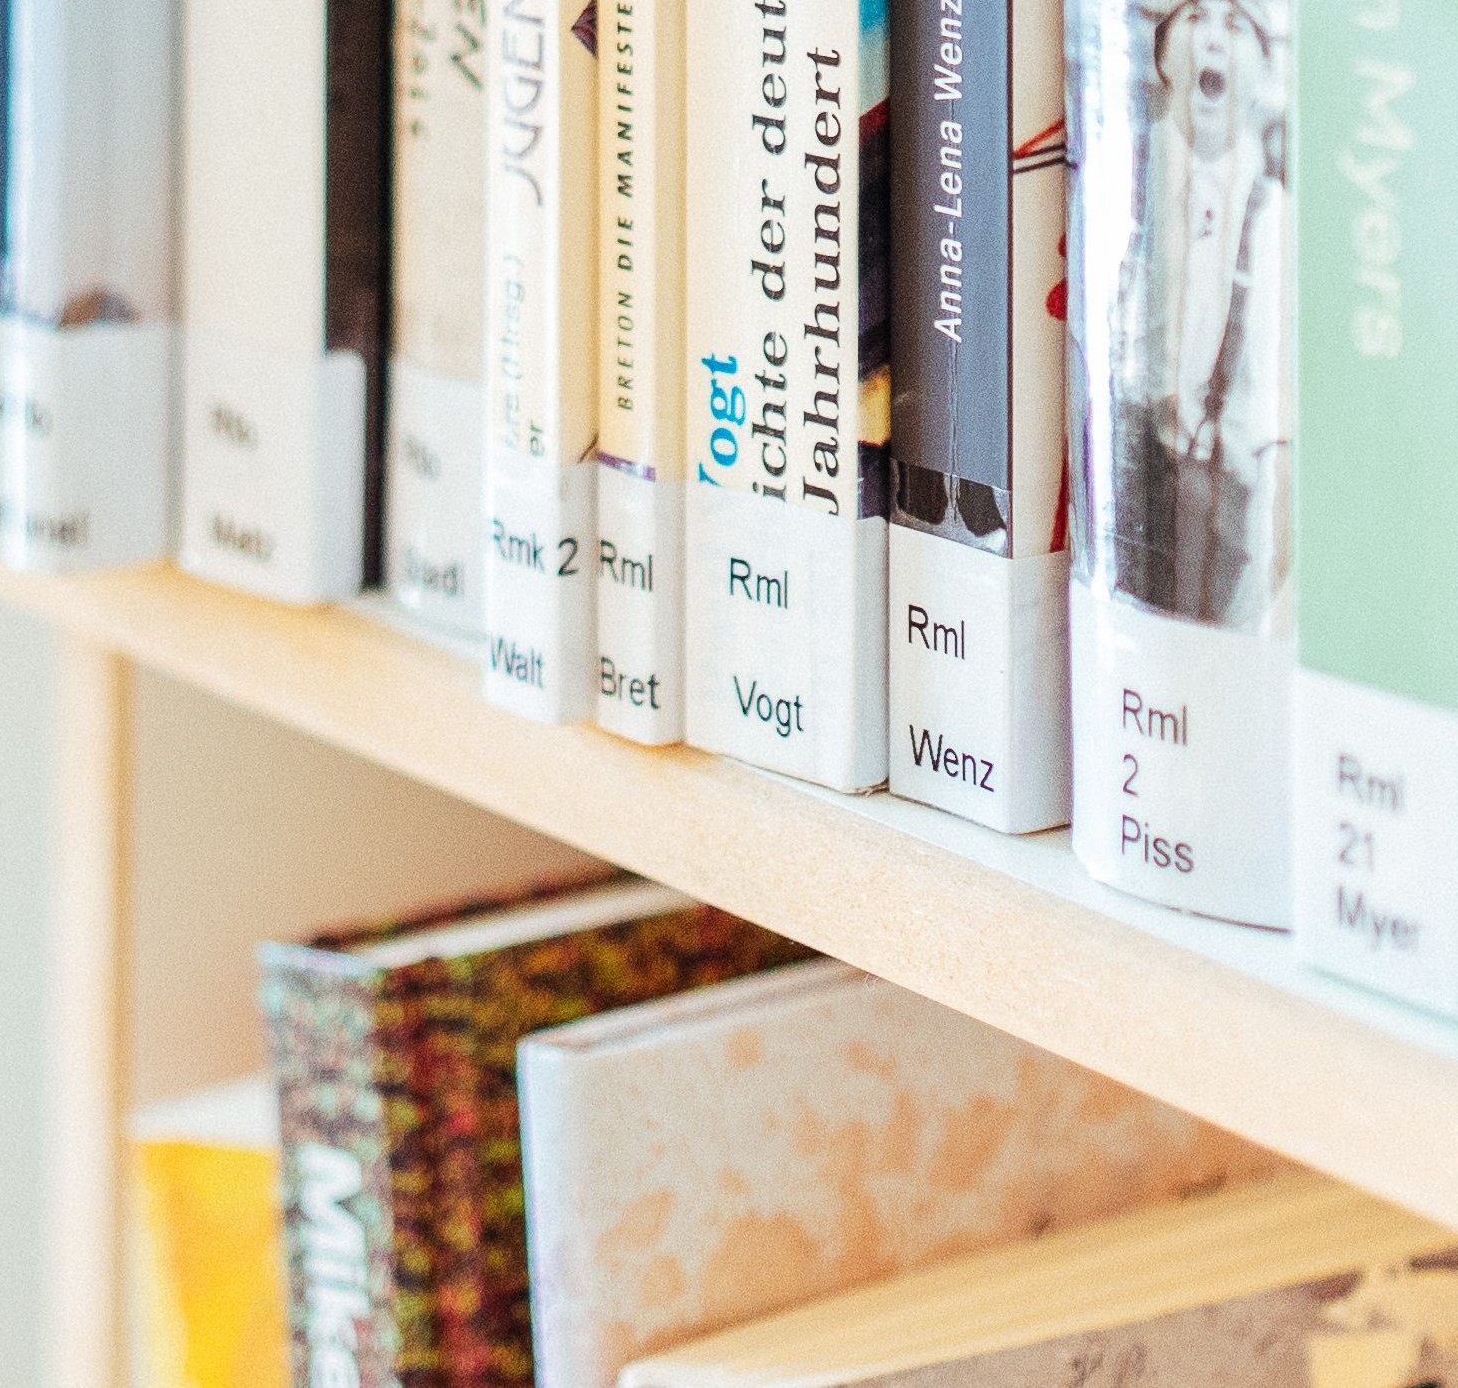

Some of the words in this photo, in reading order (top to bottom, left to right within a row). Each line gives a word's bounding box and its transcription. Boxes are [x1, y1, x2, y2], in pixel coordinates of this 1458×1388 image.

[616, 3, 634, 199] MANIFESTE
[932, 122, 964, 344] Anna-Lena
[1332, 57, 1417, 360] Myers
[616, 216, 634, 273] DIE
[750, 178, 787, 302] der
[801, 46, 841, 517] Jahrhundert
[616, 290, 634, 411] BRETON
[557, 536, 580, 578] 2
[599, 538, 654, 593] Rml
[729, 556, 789, 611] Rml
[907, 603, 966, 661] Rml
[599, 655, 661, 711] Bret
[732, 674, 805, 739] Vogt
[1121, 687, 1189, 748] Rml
[908, 724, 996, 793] Wenz
[1121, 752, 1140, 798] 2
[1120, 813, 1196, 875] Piss
[1337, 821, 1378, 871] 21
